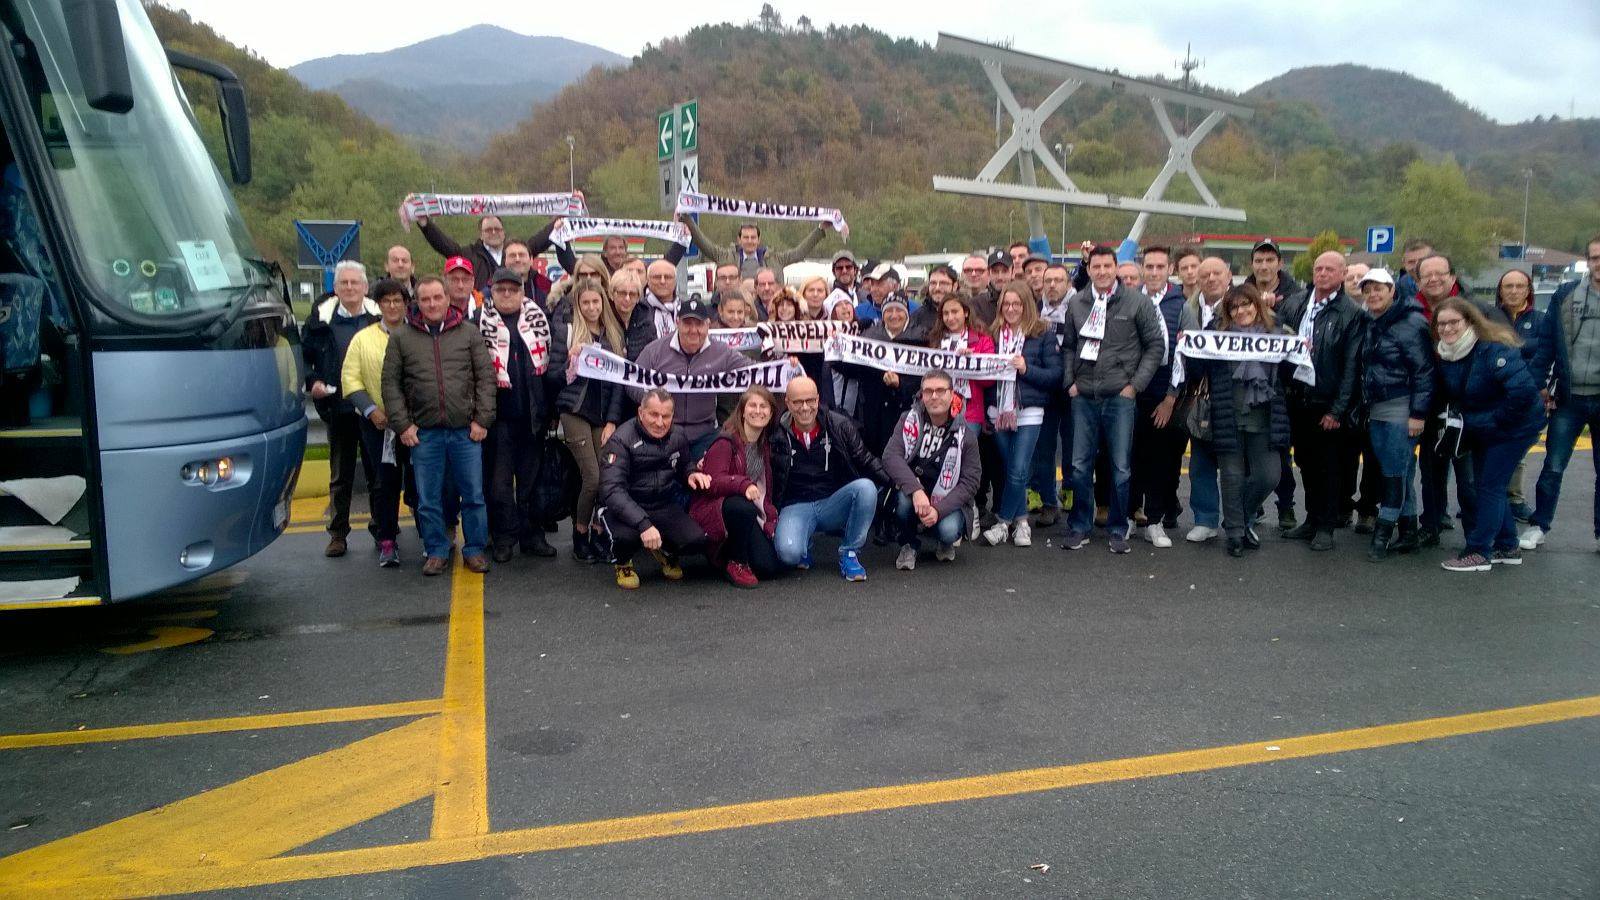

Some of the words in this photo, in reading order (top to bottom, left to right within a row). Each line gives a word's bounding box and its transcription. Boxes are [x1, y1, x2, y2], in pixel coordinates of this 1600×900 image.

[707, 195, 739, 212] PRO
[744, 200, 819, 217] VERCELLI
[1372, 229, 1389, 251] P
[851, 340, 887, 360] PRO
[893, 348, 982, 371] VERCELLI
[623, 361, 668, 387] PRO
[676, 364, 784, 390] VERCELLI
